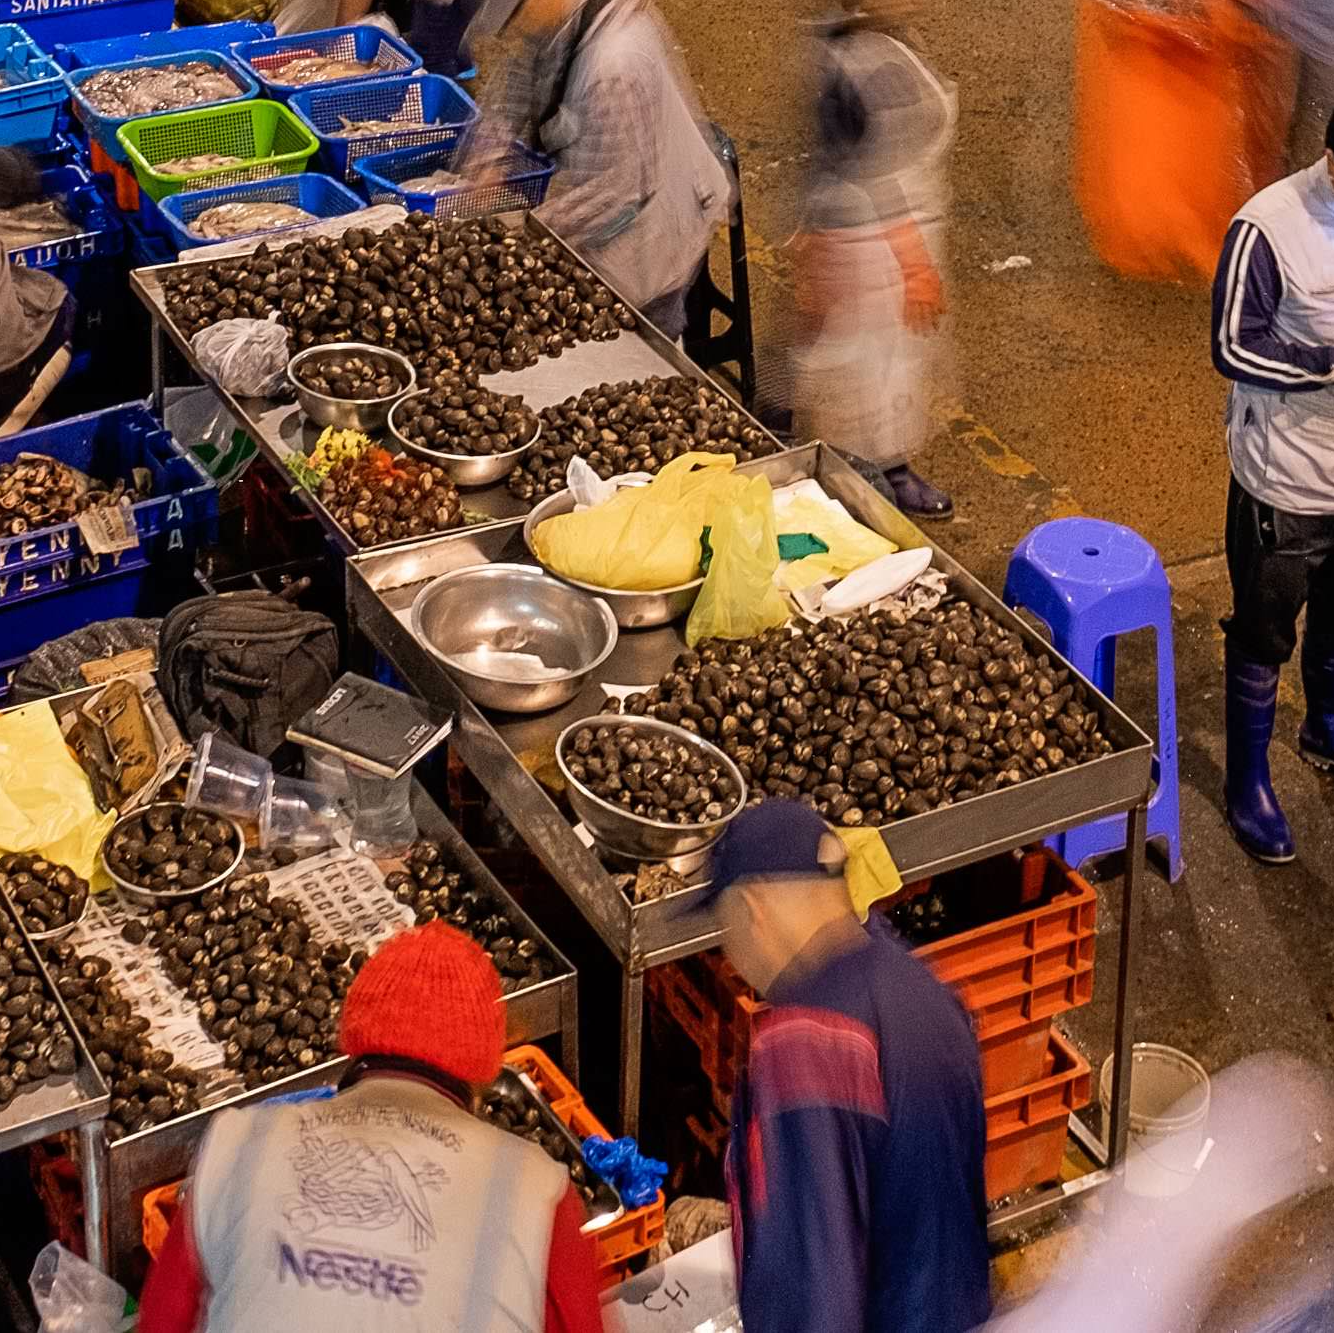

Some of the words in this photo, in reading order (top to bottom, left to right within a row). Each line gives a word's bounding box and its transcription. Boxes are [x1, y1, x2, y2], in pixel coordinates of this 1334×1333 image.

[167, 498, 183, 520] A
[167, 528, 183, 550] A
[642, 1278, 690, 1314] CH
